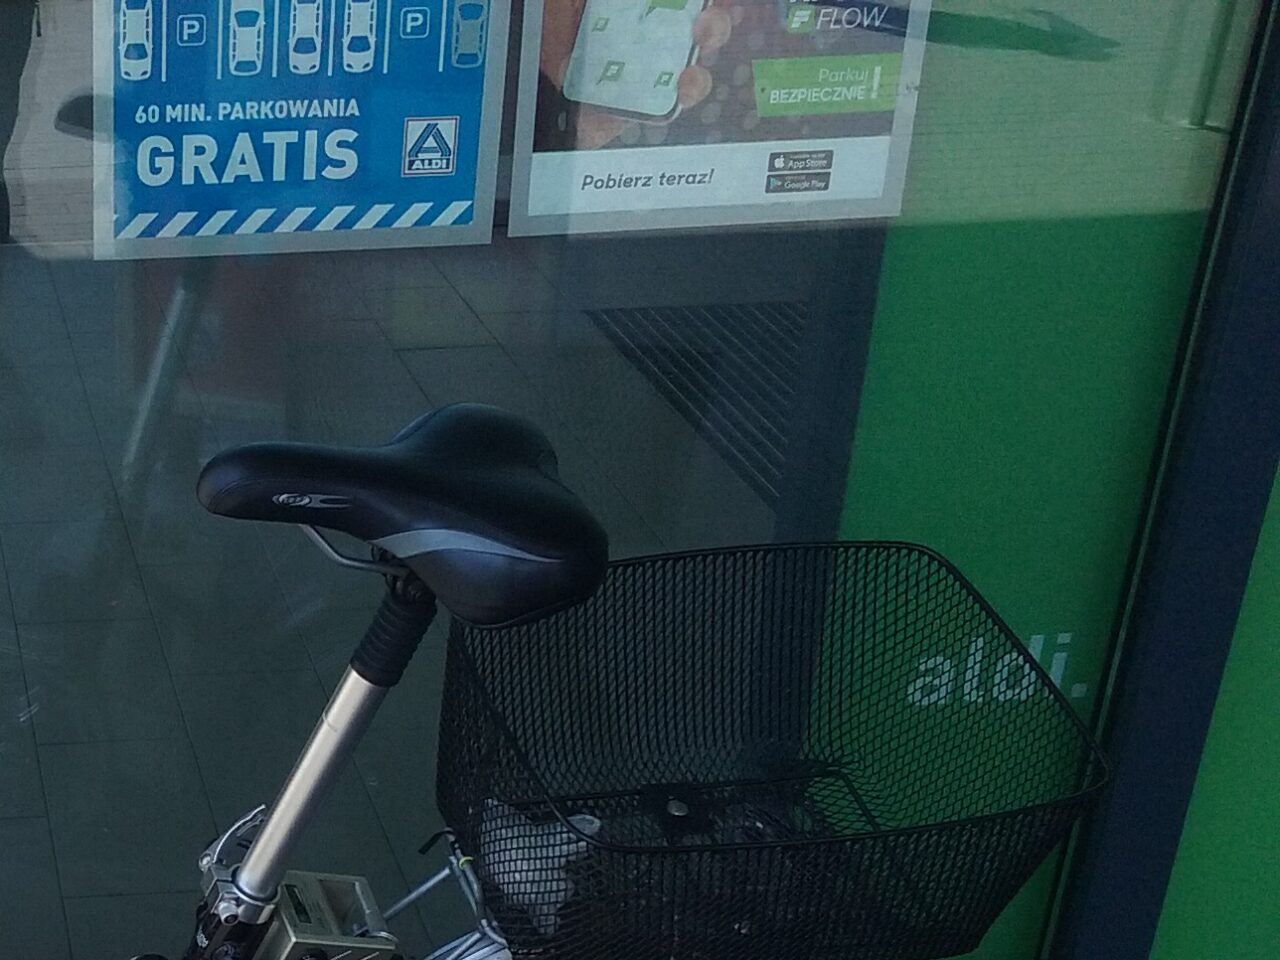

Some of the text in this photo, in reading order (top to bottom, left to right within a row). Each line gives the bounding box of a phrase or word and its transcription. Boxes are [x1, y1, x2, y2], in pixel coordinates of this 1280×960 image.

[816, 6, 889, 30] FLOW
[818, 67, 869, 84] Parkuj
[770, 86, 867, 104] BEZPIECZNIE
[135, 98, 360, 124] 60 MIN. PARKOWANIA
[136, 128, 360, 187] GRATIS
[411, 159, 448, 170] ALDI
[787, 160, 804, 169] App
[581, 167, 715, 190] Pobierz teraz!
